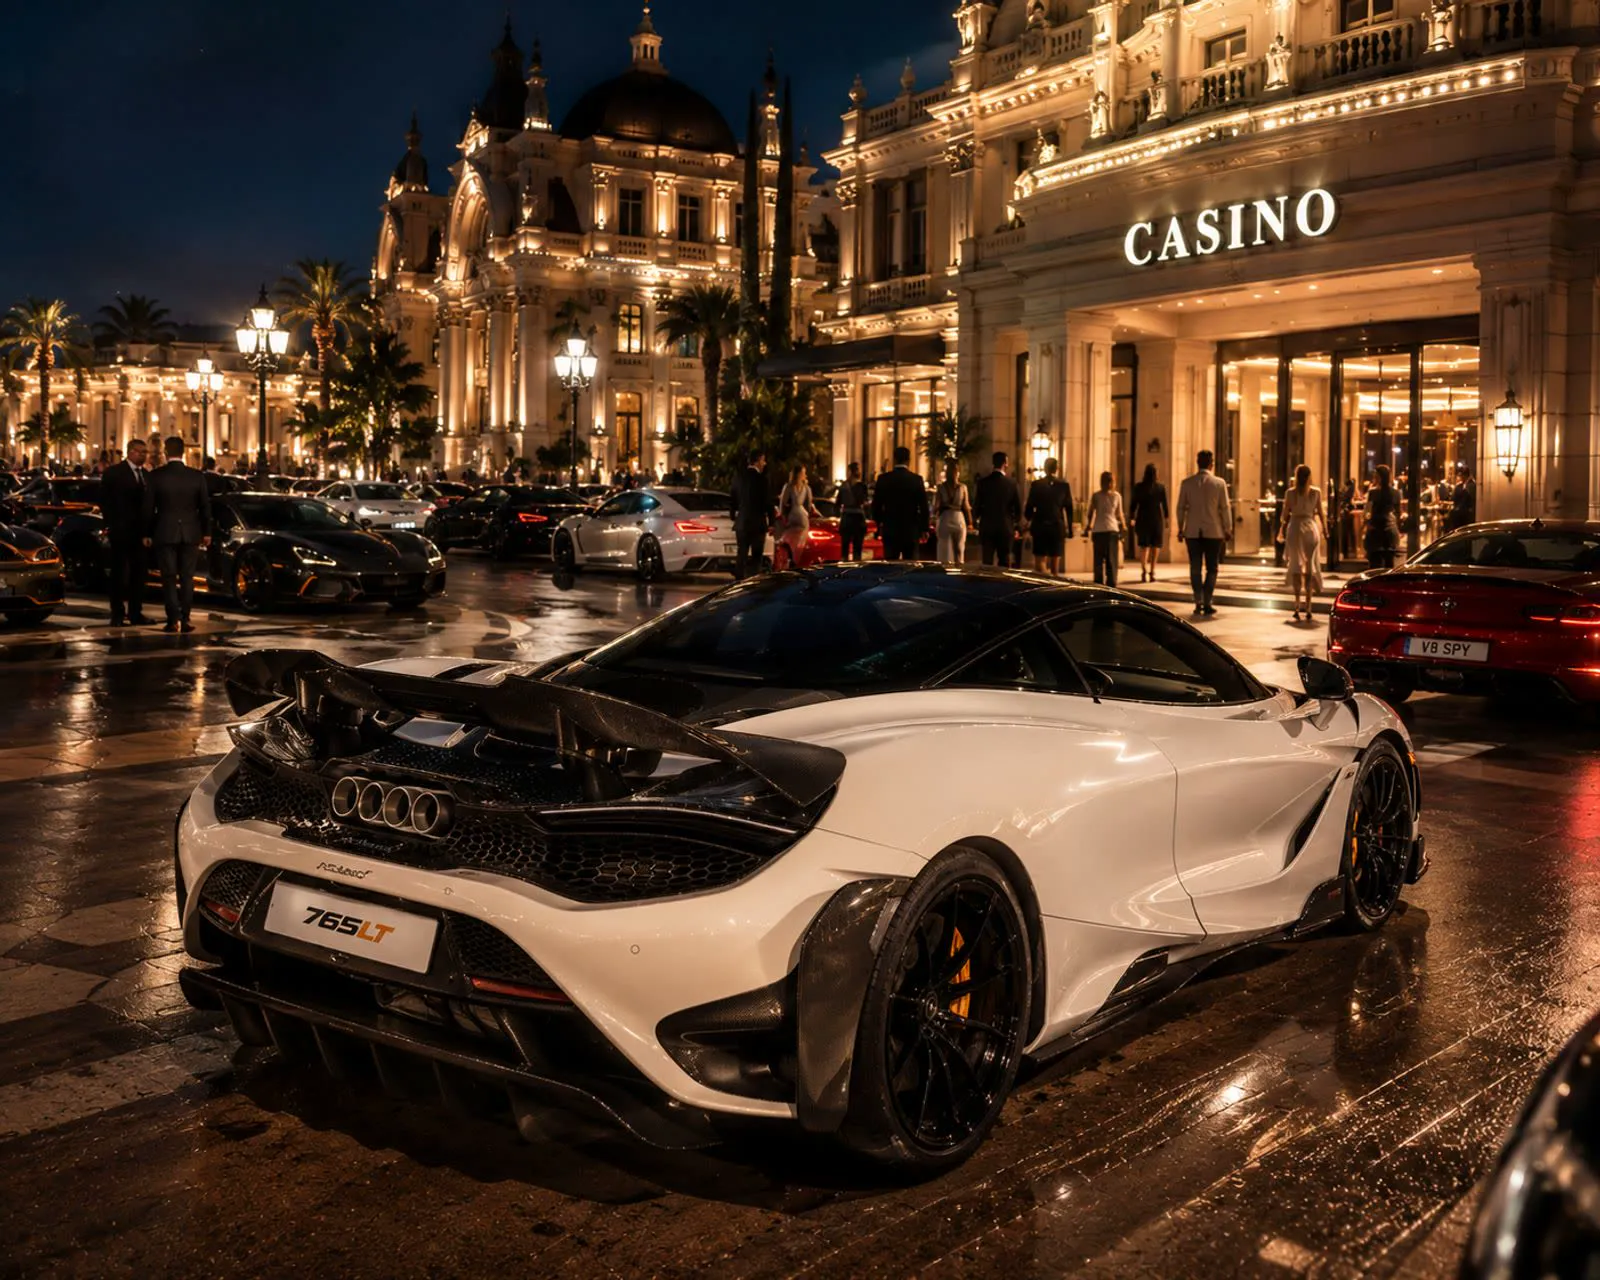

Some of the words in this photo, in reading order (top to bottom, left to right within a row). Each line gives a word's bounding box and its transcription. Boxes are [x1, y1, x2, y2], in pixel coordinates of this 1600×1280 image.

[1124, 188, 1336, 266] CASINO
[1422, 641, 1438, 654] V8
[1443, 642, 1471, 656] SPY
[303, 906, 395, 943] 765LT
